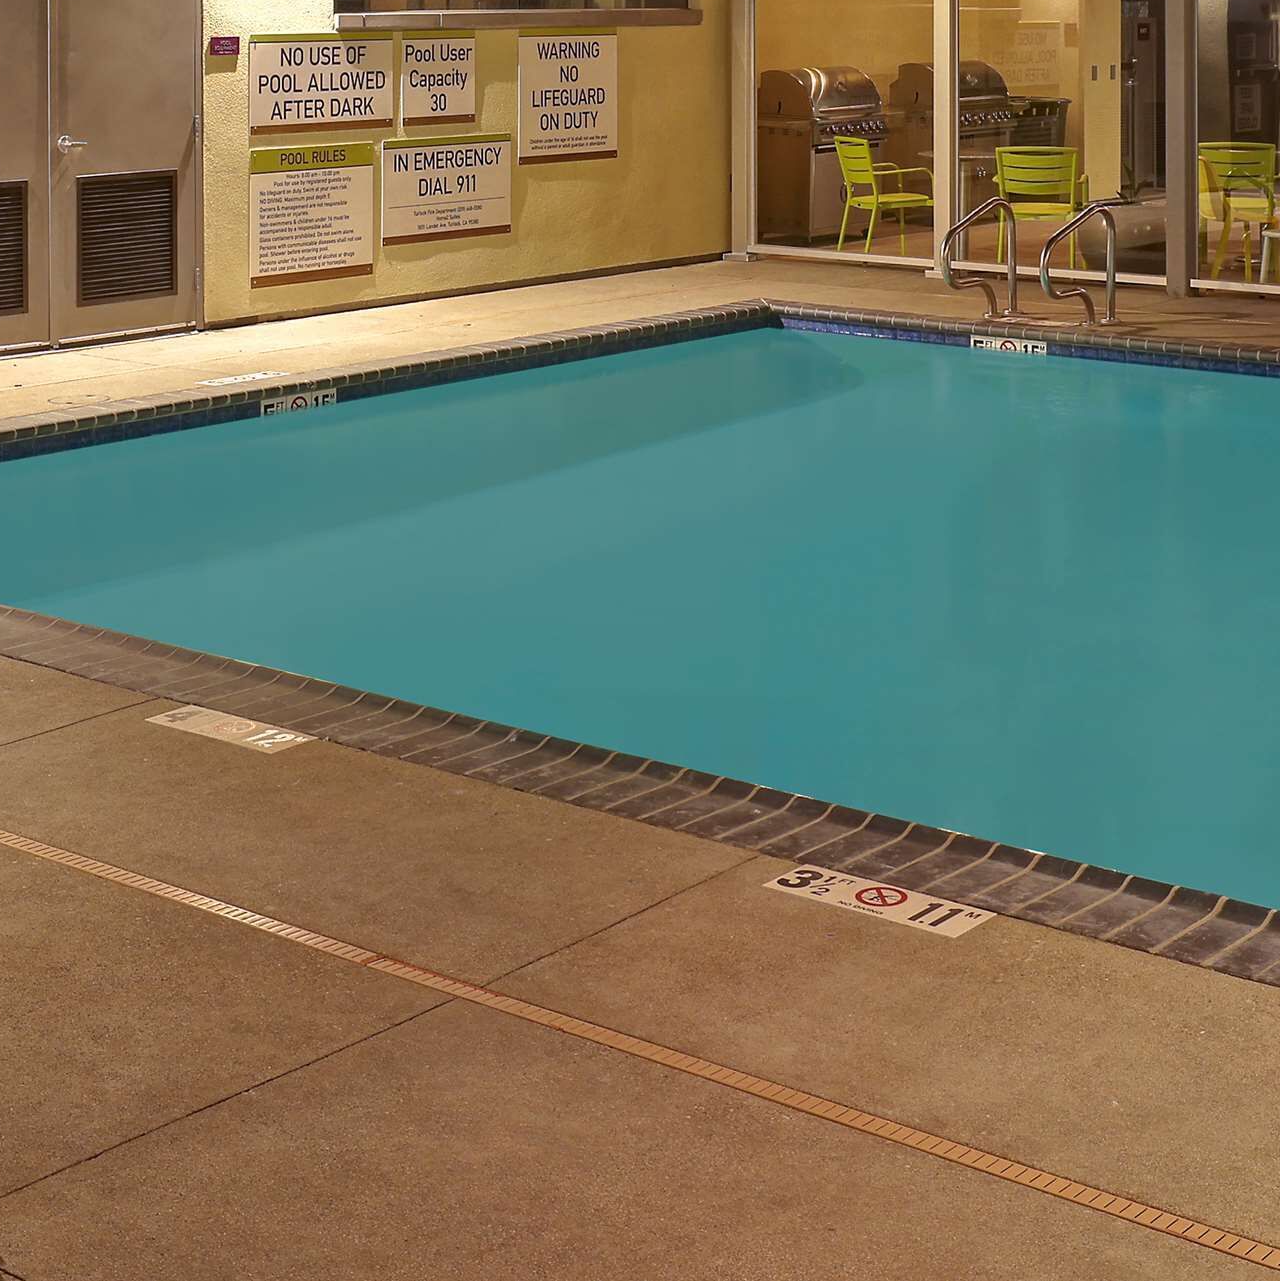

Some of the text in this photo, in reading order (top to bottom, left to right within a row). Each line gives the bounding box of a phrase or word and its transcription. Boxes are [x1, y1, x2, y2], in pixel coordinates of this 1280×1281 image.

[280, 46, 366, 66] NO USE OF
[405, 43, 473, 63] Pool User
[537, 41, 600, 60] WARNING
[259, 70, 386, 94] POOL ALLOWED
[409, 68, 468, 92] Capacity
[560, 65, 579, 83] NO
[430, 93, 447, 112] 30
[532, 87, 606, 107] LIFEGUARD
[271, 97, 375, 120] AFTER DARK
[540, 111, 598, 131] ON DUTY
[280, 150, 346, 166] POOL RULES
[393, 147, 502, 172] IN EMERGENCY
[419, 174, 476, 197] DIAL 911
[964, 911, 982, 920] M
